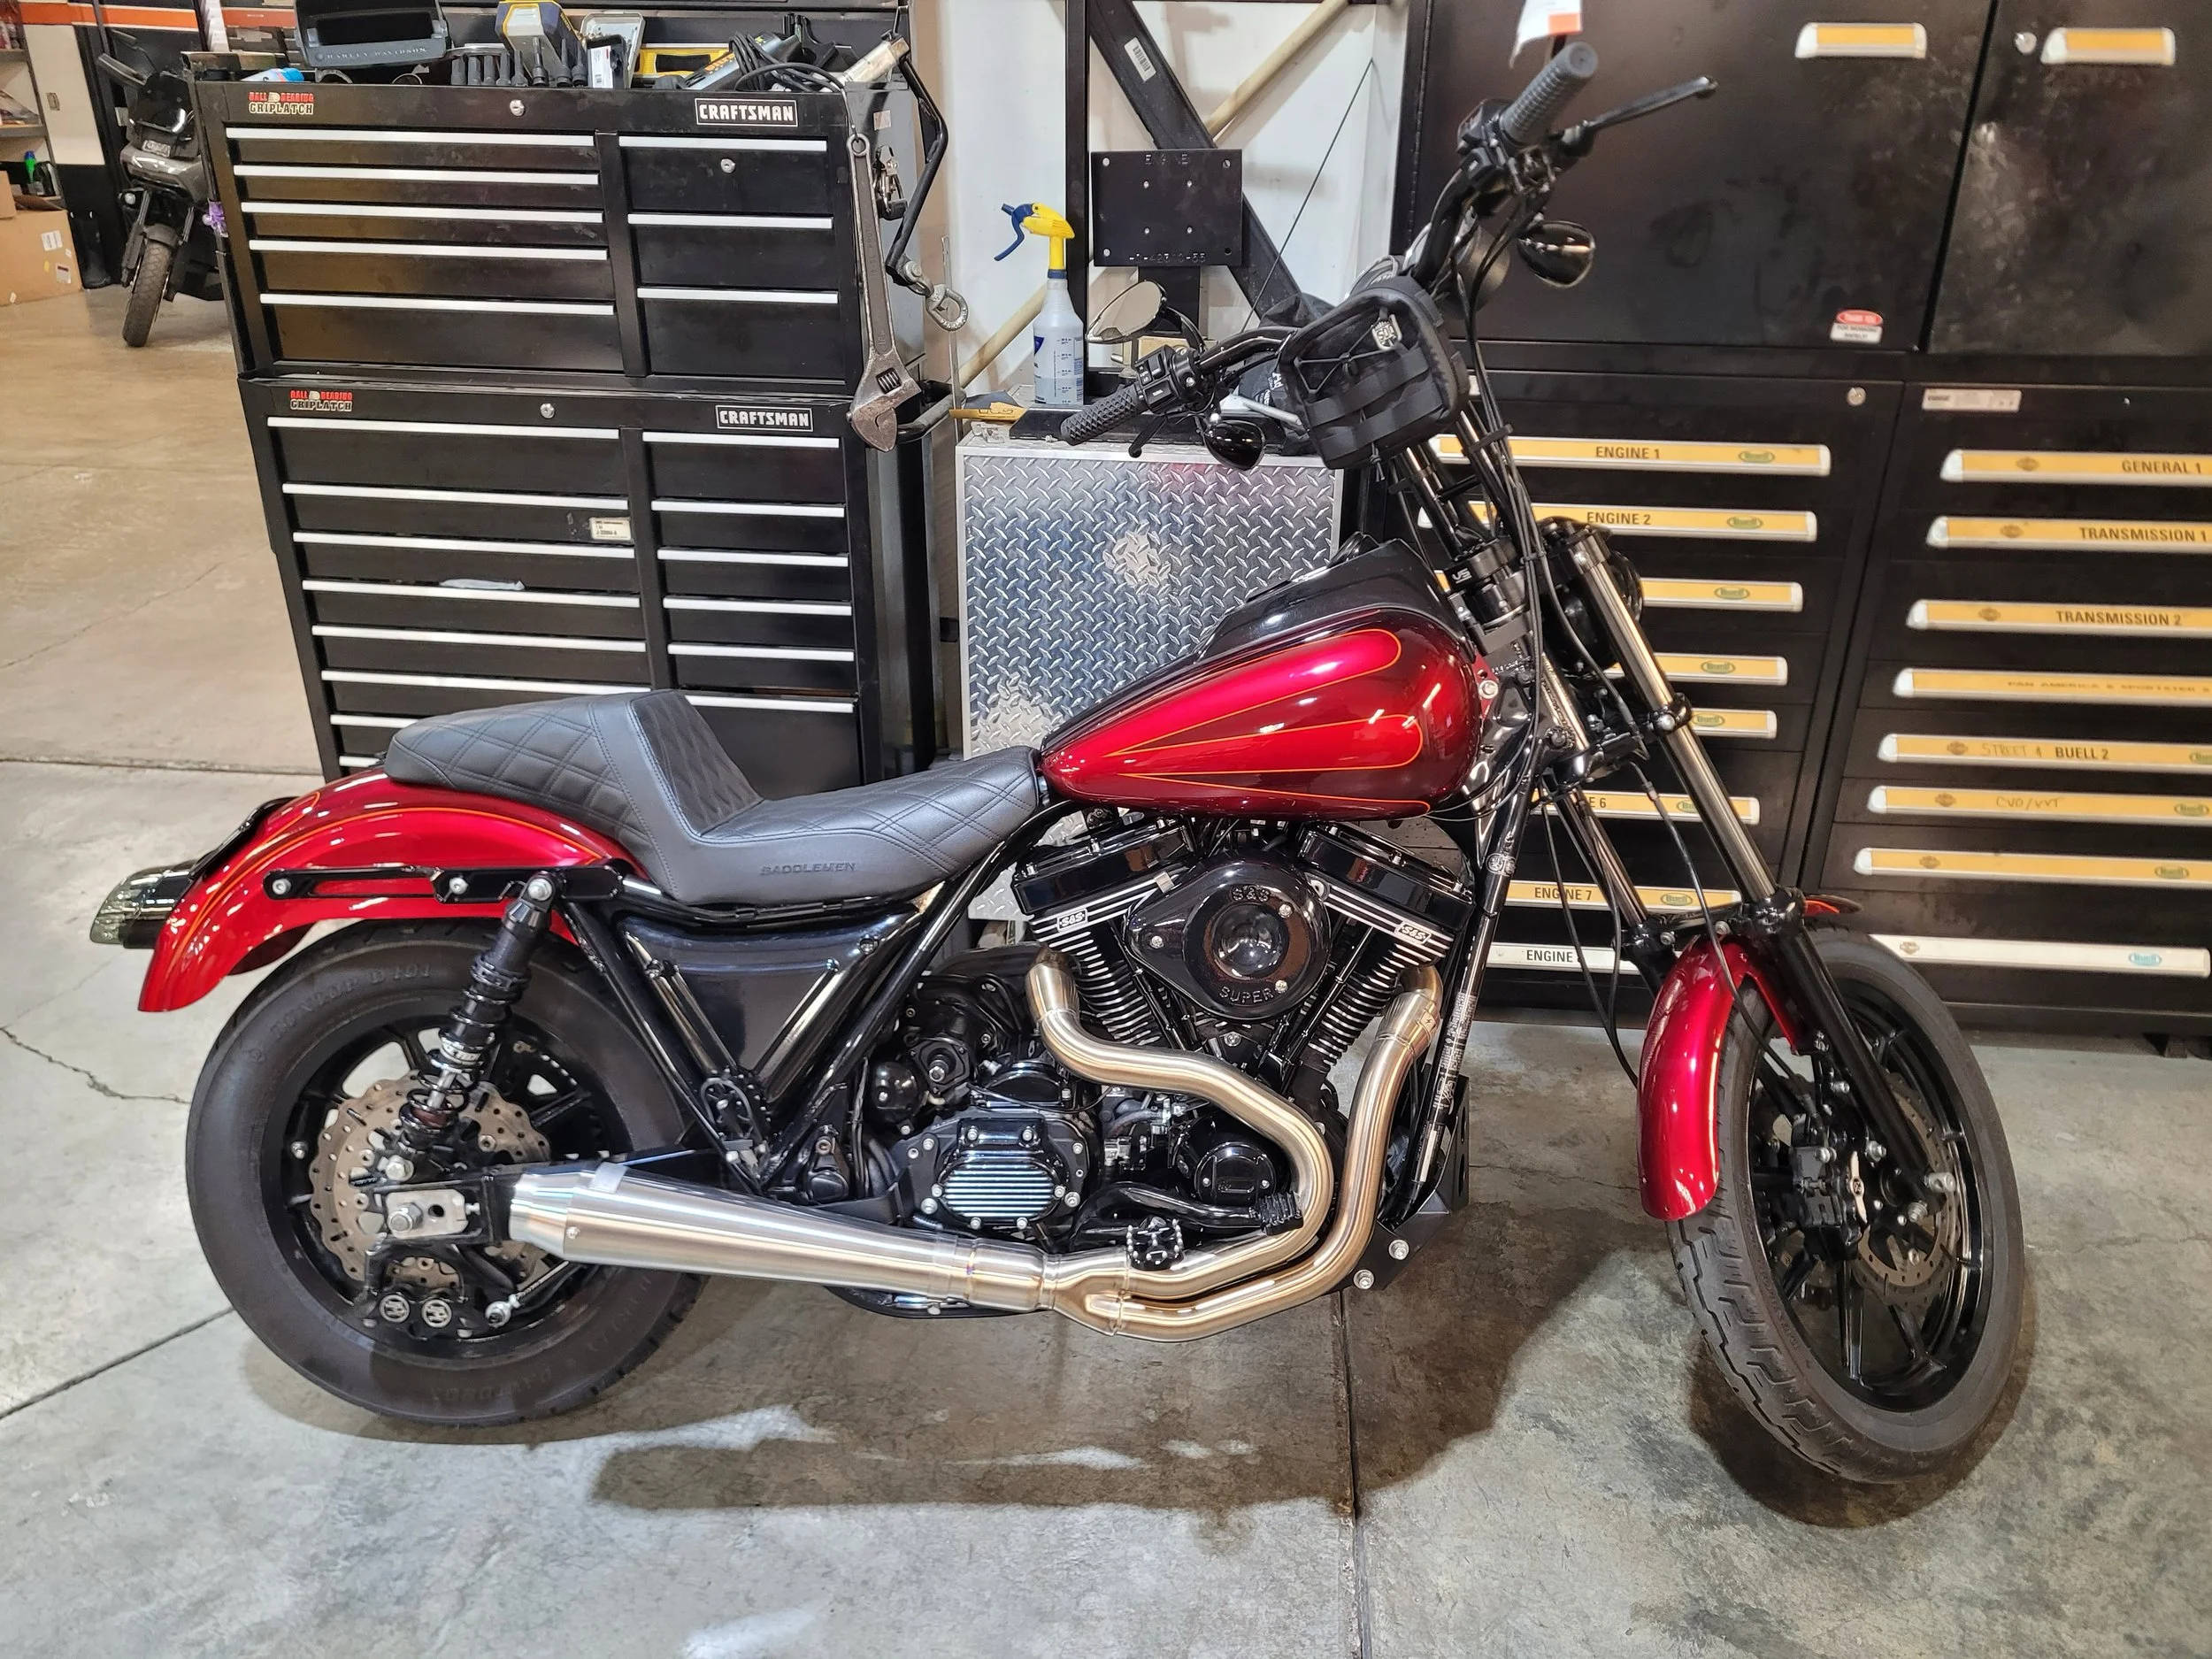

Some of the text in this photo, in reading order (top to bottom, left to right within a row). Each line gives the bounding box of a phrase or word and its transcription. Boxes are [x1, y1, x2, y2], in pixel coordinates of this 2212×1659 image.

[249, 102, 314, 115] GRIPLATCH
[699, 104, 794, 121] CRAFTSMAN
[290, 398, 352, 412] GRIPLATCH
[718, 410, 810, 427] CRAFTSMAN
[1595, 446, 1661, 459] ENGINE 1
[2122, 459, 2203, 475] GENERAL 1
[1586, 511, 1651, 526] ENGINE 2
[2079, 526, 2208, 543] TRANSMISSION 1
[2056, 610, 2182, 626] TRANSMISSION 2
[2055, 746, 2109, 760] BUELL 2
[1599, 797, 1607, 809] 6
[1233, 887, 1271, 902] S&S
[1534, 887, 1593, 901] ENGNE 7
[1060, 913, 1085, 927] S&S
[1402, 925, 1427, 941] S&S
[1526, 949, 1573, 963] ENGINE
[1219, 987, 1275, 1003] SUPER
